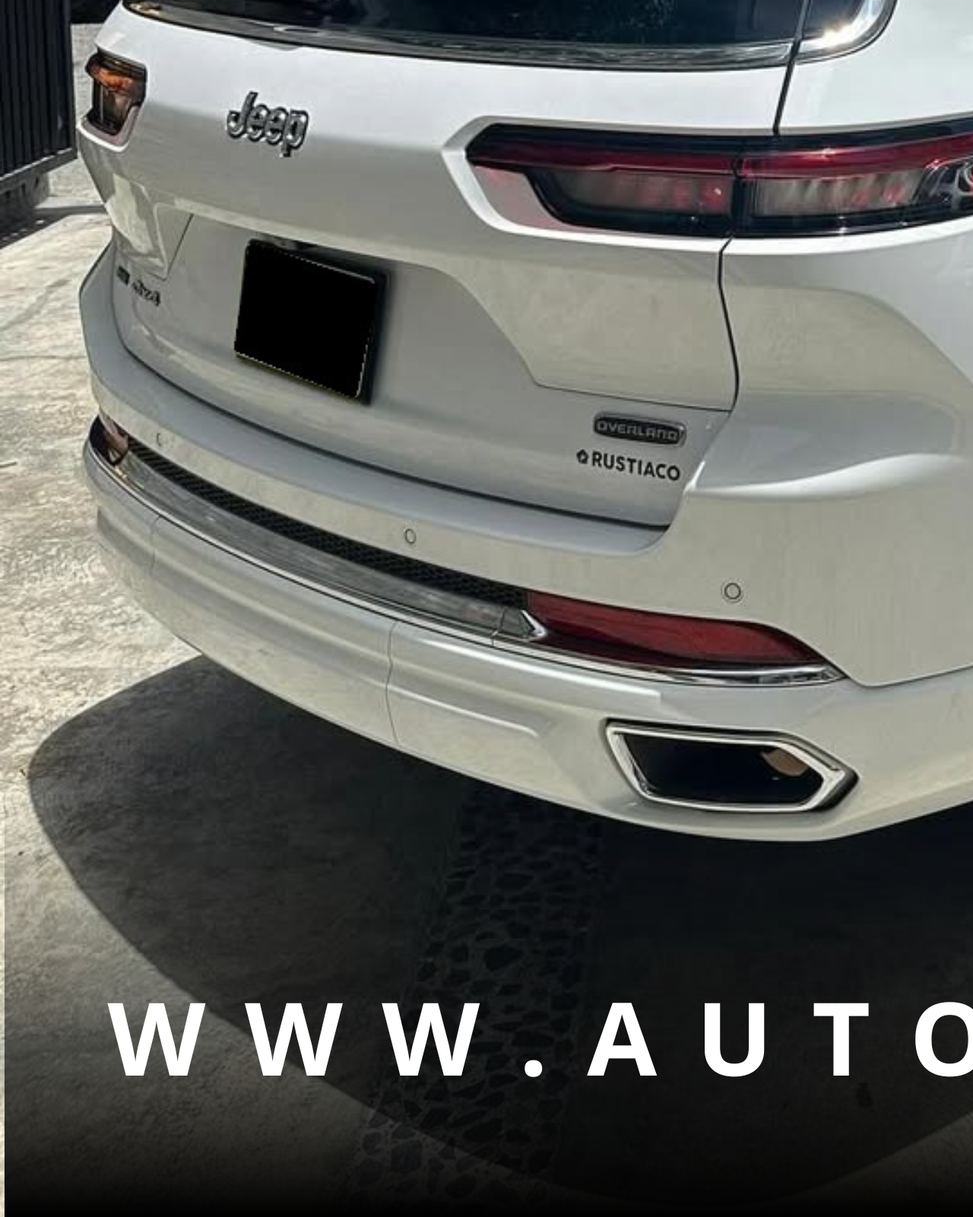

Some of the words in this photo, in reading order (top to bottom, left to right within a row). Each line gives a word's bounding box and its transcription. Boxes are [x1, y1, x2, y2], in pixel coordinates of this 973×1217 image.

[226, 90, 309, 158] Jeep
[596, 420, 678, 441] OVERLAND
[592, 450, 681, 481] RUSTIACO
